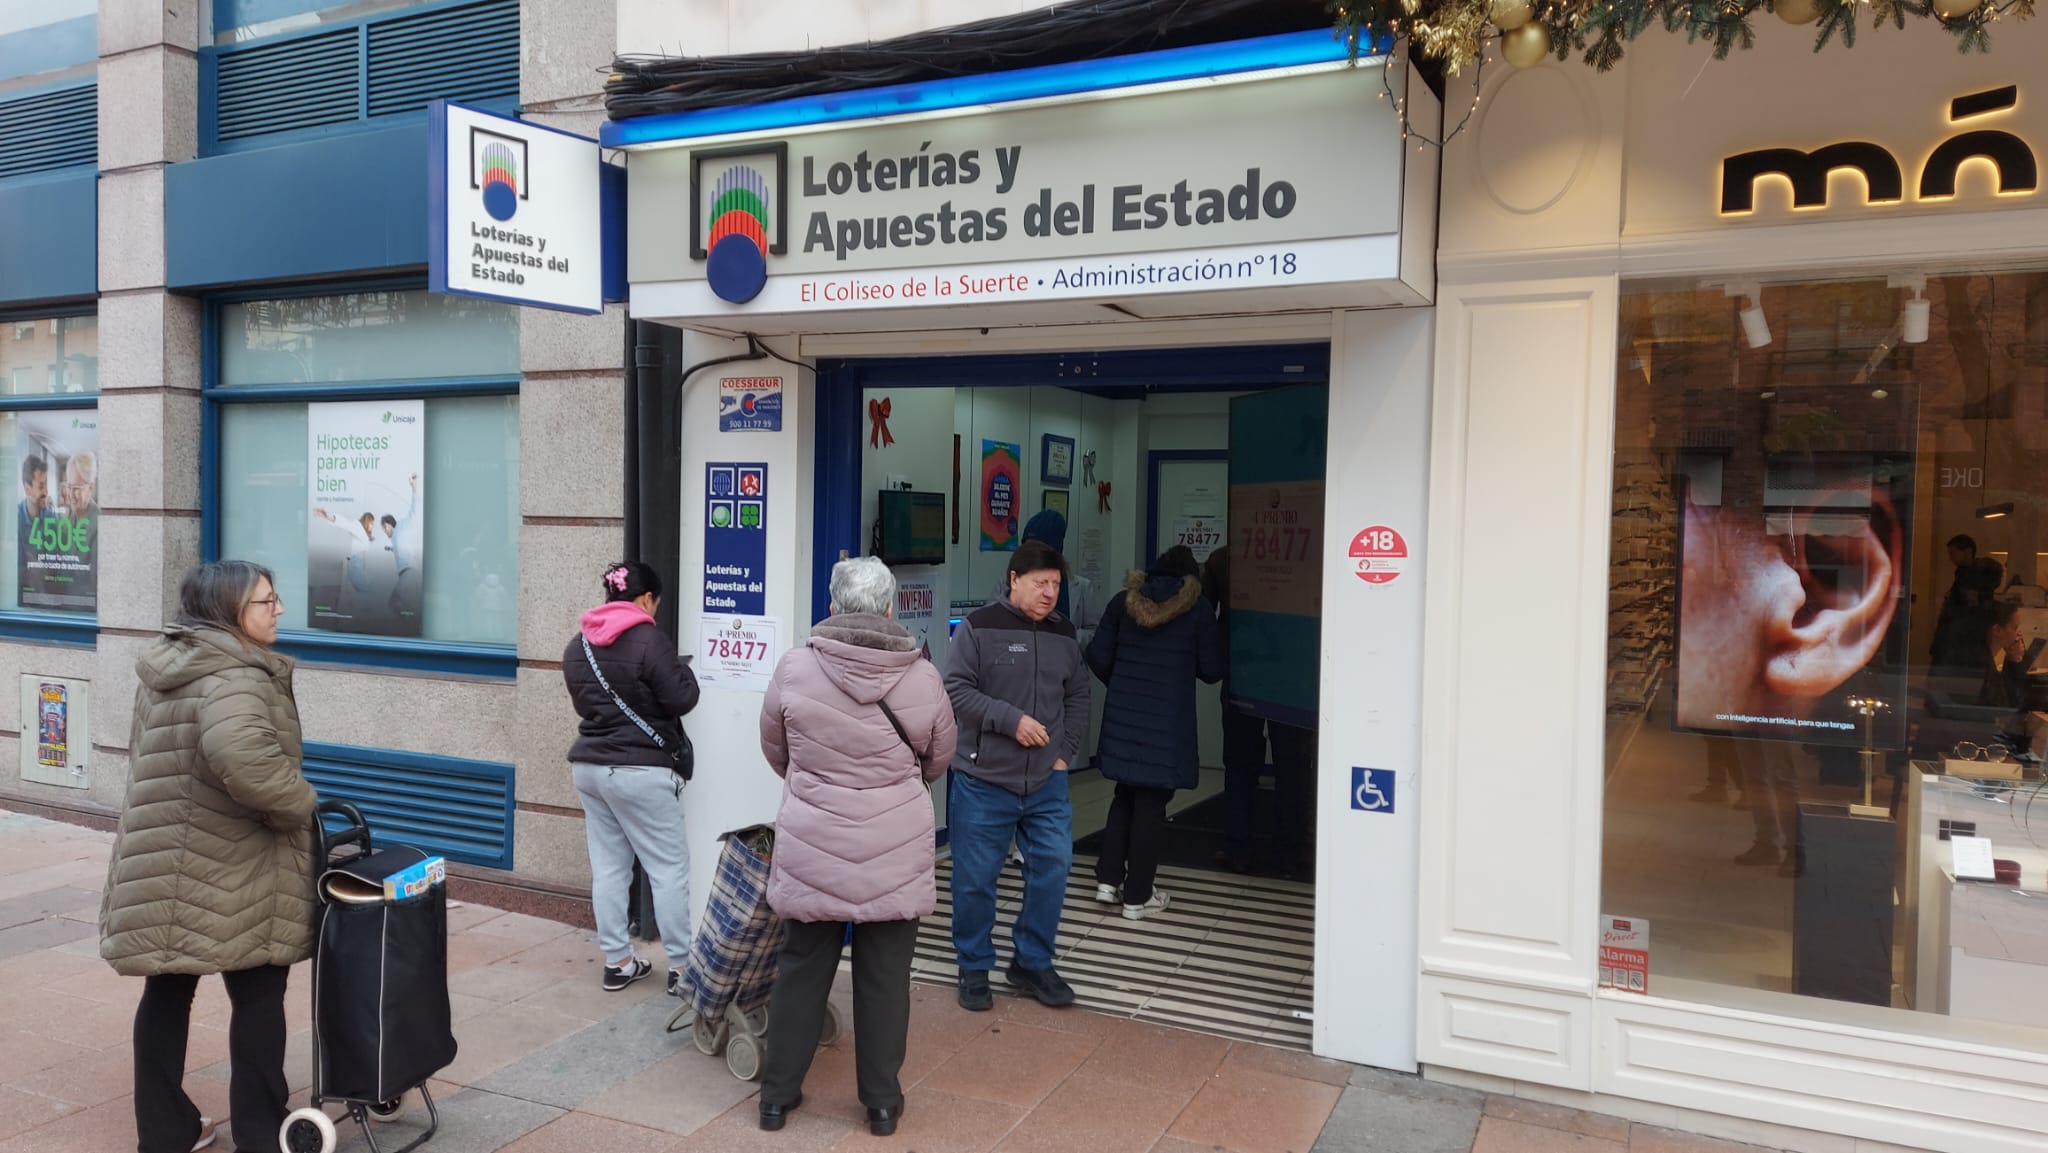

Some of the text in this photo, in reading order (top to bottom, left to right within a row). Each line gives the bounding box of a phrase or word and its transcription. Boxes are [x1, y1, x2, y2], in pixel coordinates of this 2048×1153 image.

[803, 141, 1021, 197] Loterías y
[803, 168, 1297, 260] Apuestas del Estado
[538, 238, 546, 252] y
[472, 243, 569, 273] Apuestas del
[472, 263, 525, 285] Estado
[801, 282, 816, 302] El
[824, 280, 895, 301] Coliseo
[902, 277, 927, 297] de
[935, 275, 951, 296] la
[960, 273, 1029, 295] Suerte
[1052, 258, 1232, 289] Administración
[1269, 253, 1297, 276] 18
[722, 378, 779, 388] COESSEGUR
[393, 416, 415, 424] Unicaja
[317, 453, 381, 474] para vivir
[317, 475, 346, 492] bien
[28, 516, 91, 553] 450€
[1178, 533, 1220, 545] 78477
[1360, 531, 1394, 550] +18
[1241, 528, 1312, 562] 78477
[743, 567, 750, 578] y
[706, 580, 763, 593] Apuestas del
[705, 596, 736, 608] Estado
[898, 590, 933, 611] INVIERNO
[728, 630, 757, 640] PREMIO
[708, 638, 767, 661] 78477
[1730, 713, 1768, 723] inteligencia
[1798, 719, 1814, 727] para
[1815, 721, 1828, 729] que
[1830, 721, 1856, 730] tengas
[1600, 948, 1645, 964] Alarma
